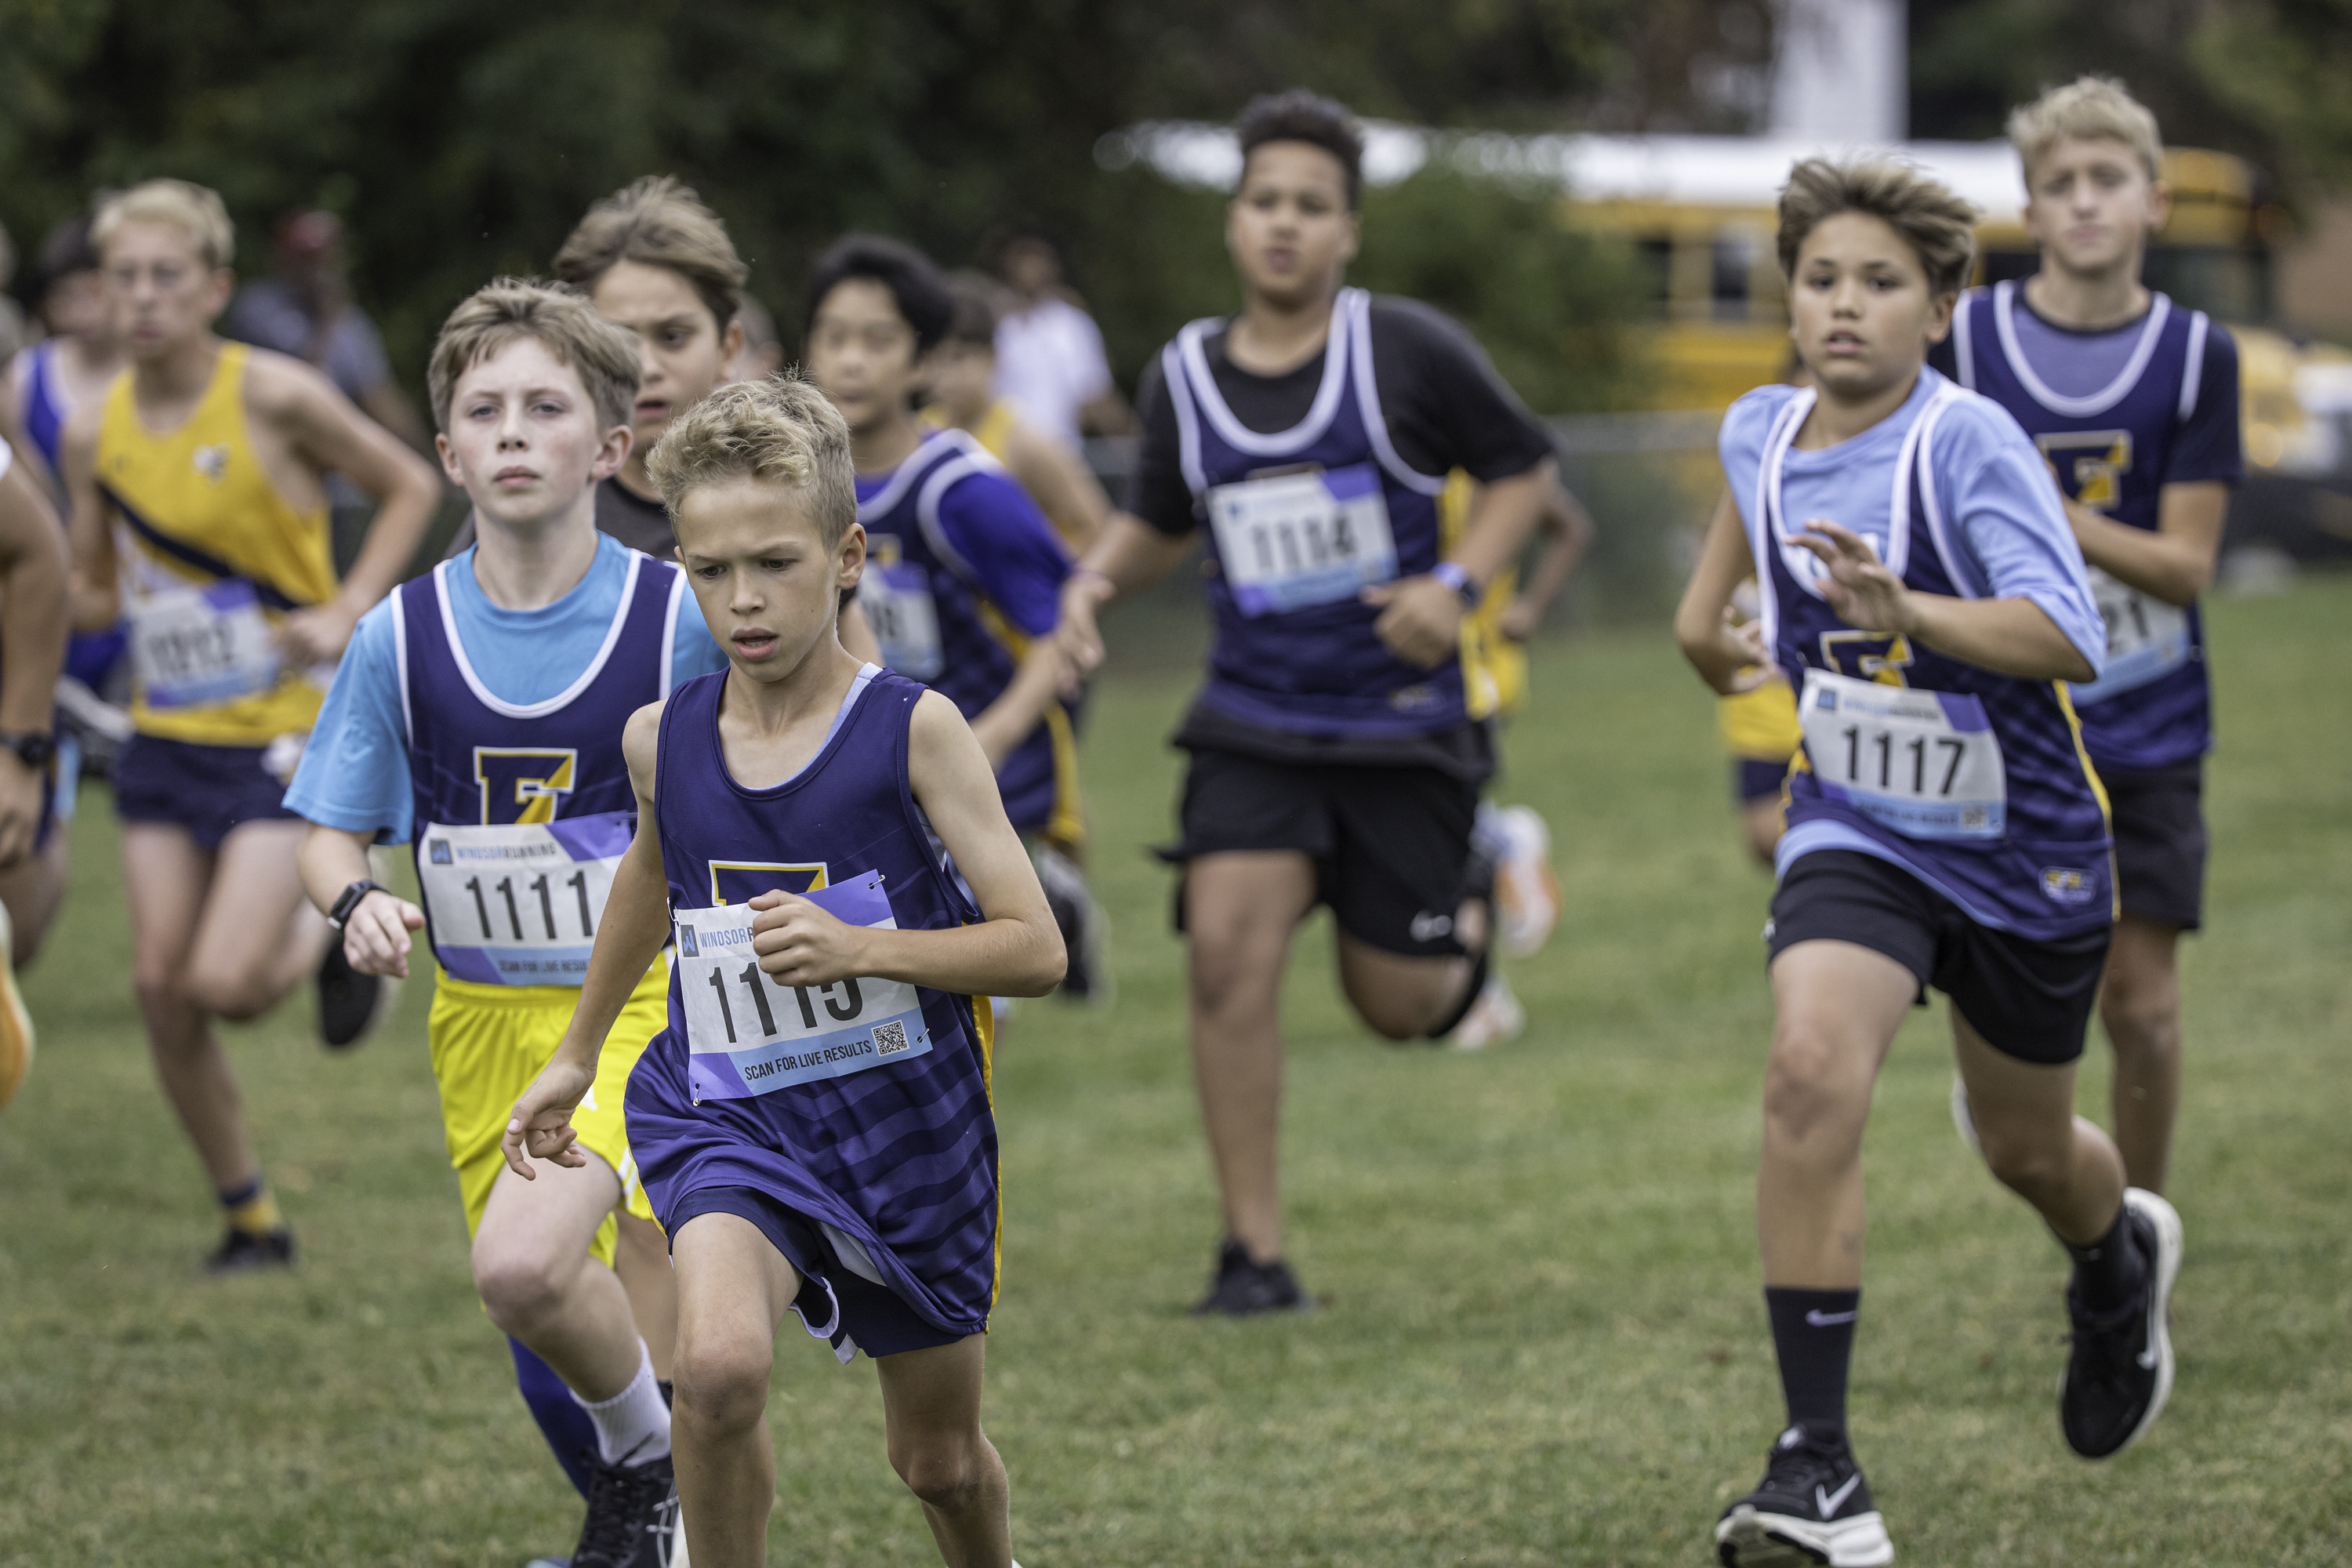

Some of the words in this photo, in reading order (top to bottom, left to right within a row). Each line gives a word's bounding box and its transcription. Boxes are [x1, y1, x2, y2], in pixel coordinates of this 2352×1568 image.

[1250, 514, 1360, 570] 1114
[1842, 725, 1966, 797] 1117
[466, 869, 593, 940] 1111
[709, 962, 862, 1043] 1115
[744, 1061, 775, 1081] SCAN
[775, 1055, 798, 1073] FOR
[797, 1051, 823, 1068] LIVE
[823, 1040, 873, 1063] RESULTS
